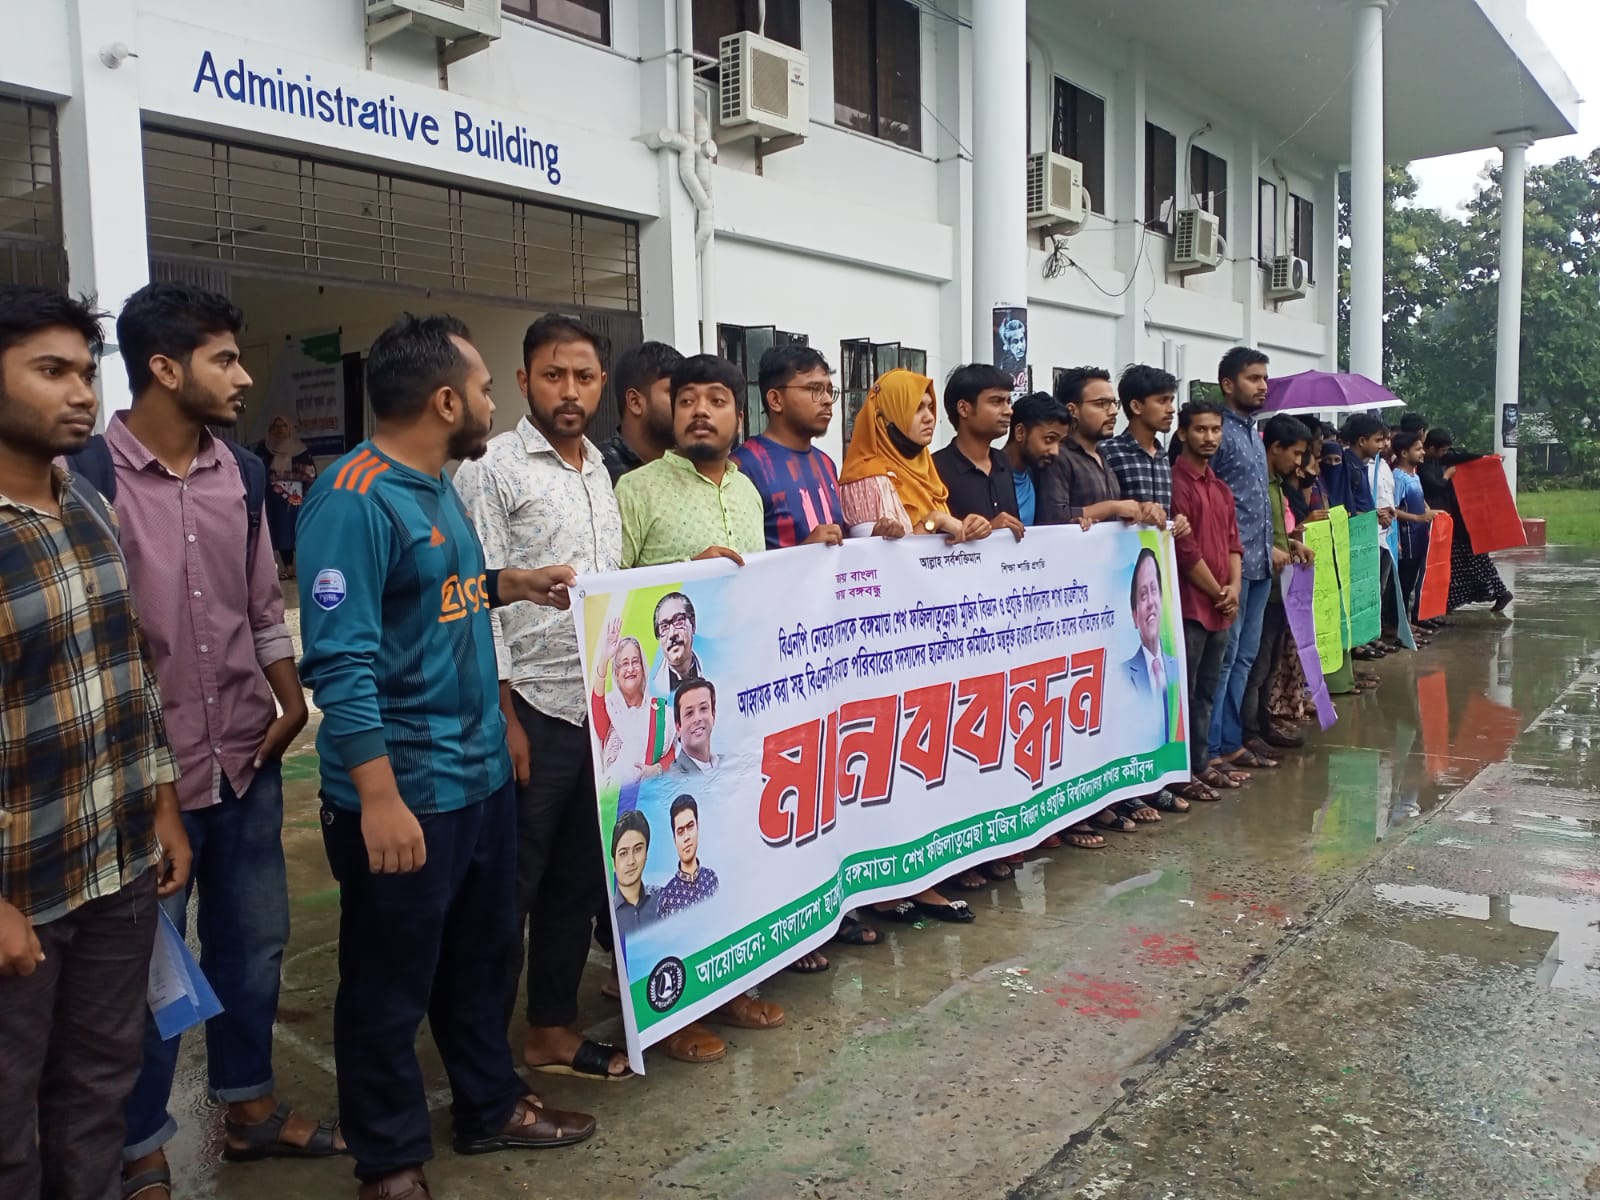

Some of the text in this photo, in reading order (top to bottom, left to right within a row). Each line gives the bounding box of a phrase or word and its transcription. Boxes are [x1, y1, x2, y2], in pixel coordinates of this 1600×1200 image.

[192, 50, 562, 186] Administrative Building
[848, 584, 882, 598] বঙ্গবন্ধু
[850, 569, 878, 581] বাংলা
[920, 552, 982, 570] আল্লাহ সর্বশক্তিমান
[778, 622, 808, 661] বিএনপি
[811, 624, 834, 653] নেতার
[859, 613, 891, 640] বঙ্গমাতা
[893, 610, 907, 635] শেখ
[909, 600, 958, 633] ফজিলাতুন্নেছা
[959, 595, 978, 630] মুজিব
[978, 593, 998, 621] বিজ্ঞান
[999, 597, 1006, 615] ও
[1006, 588, 1022, 619] প্রযুক্তি
[737, 683, 771, 718] আহ্বায়ক
[773, 675, 789, 705] করা
[790, 673, 807, 701] সহ
[851, 646, 893, 679] পরিবারের
[894, 643, 927, 671] সদস্যদের
[928, 632, 965, 664] ছাত্রলীগের
[966, 626, 996, 656] কমিটিতে
[1055, 620, 1061, 637] ও
[758, 648, 1106, 848] মানববন্ধন
[695, 930, 766, 985] আয়োজনে:
[769, 895, 821, 946] বাংলাদেশ
[845, 855, 897, 887] বঙ্গমাতা
[902, 843, 925, 875] শেখ
[927, 819, 984, 862] ফজিলাতুন্নেছা
[987, 809, 1018, 843] মুজিব
[1020, 803, 1039, 832] বিজ্ঞান
[1040, 801, 1046, 818] ও
[1046, 787, 1066, 816] প্রযুক্তি
[1067, 778, 1102, 806] বিশ্ববিদ্যালয়
[1103, 766, 1119, 788] শাখার
[1121, 757, 1154, 784] কর্মীবৃন্দ
